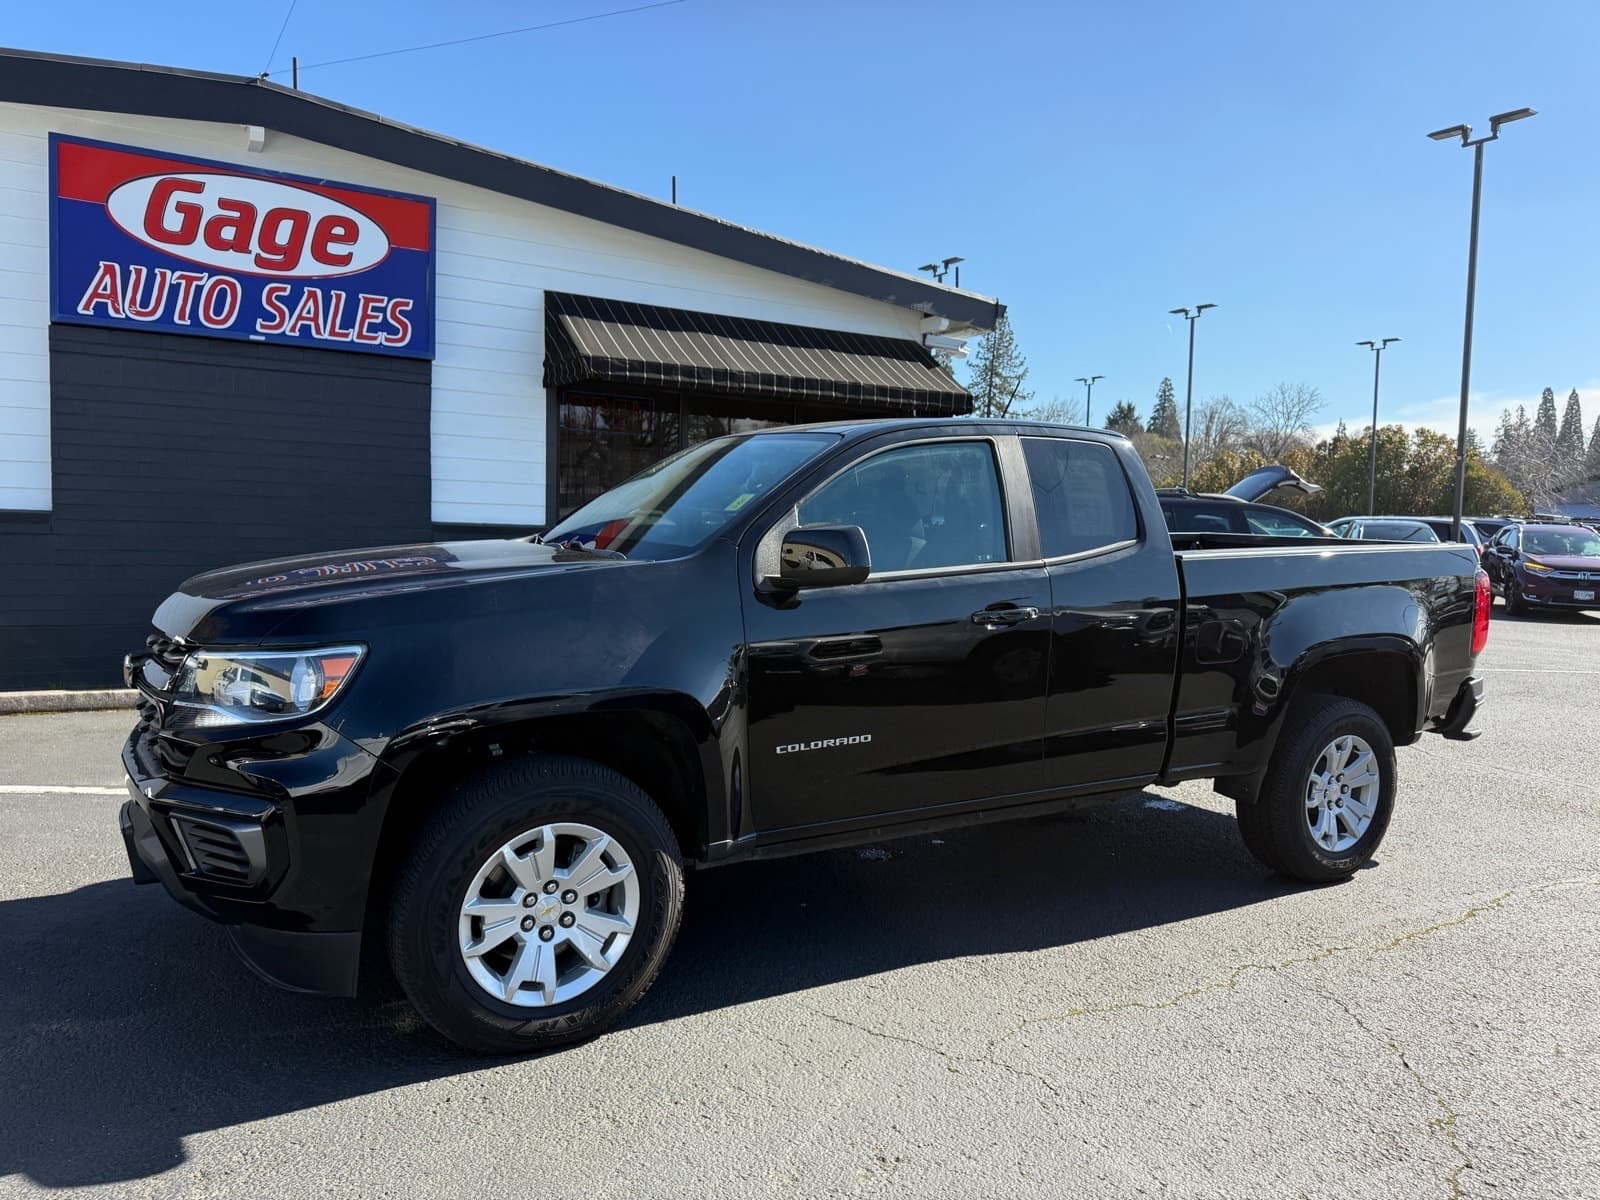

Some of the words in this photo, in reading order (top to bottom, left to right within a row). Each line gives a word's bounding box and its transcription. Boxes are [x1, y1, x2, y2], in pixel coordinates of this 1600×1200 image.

[143, 177, 360, 272] Gage
[77, 261, 242, 330] AUTO
[255, 283, 414, 347] SALES
[775, 734, 872, 754] COLORADO
